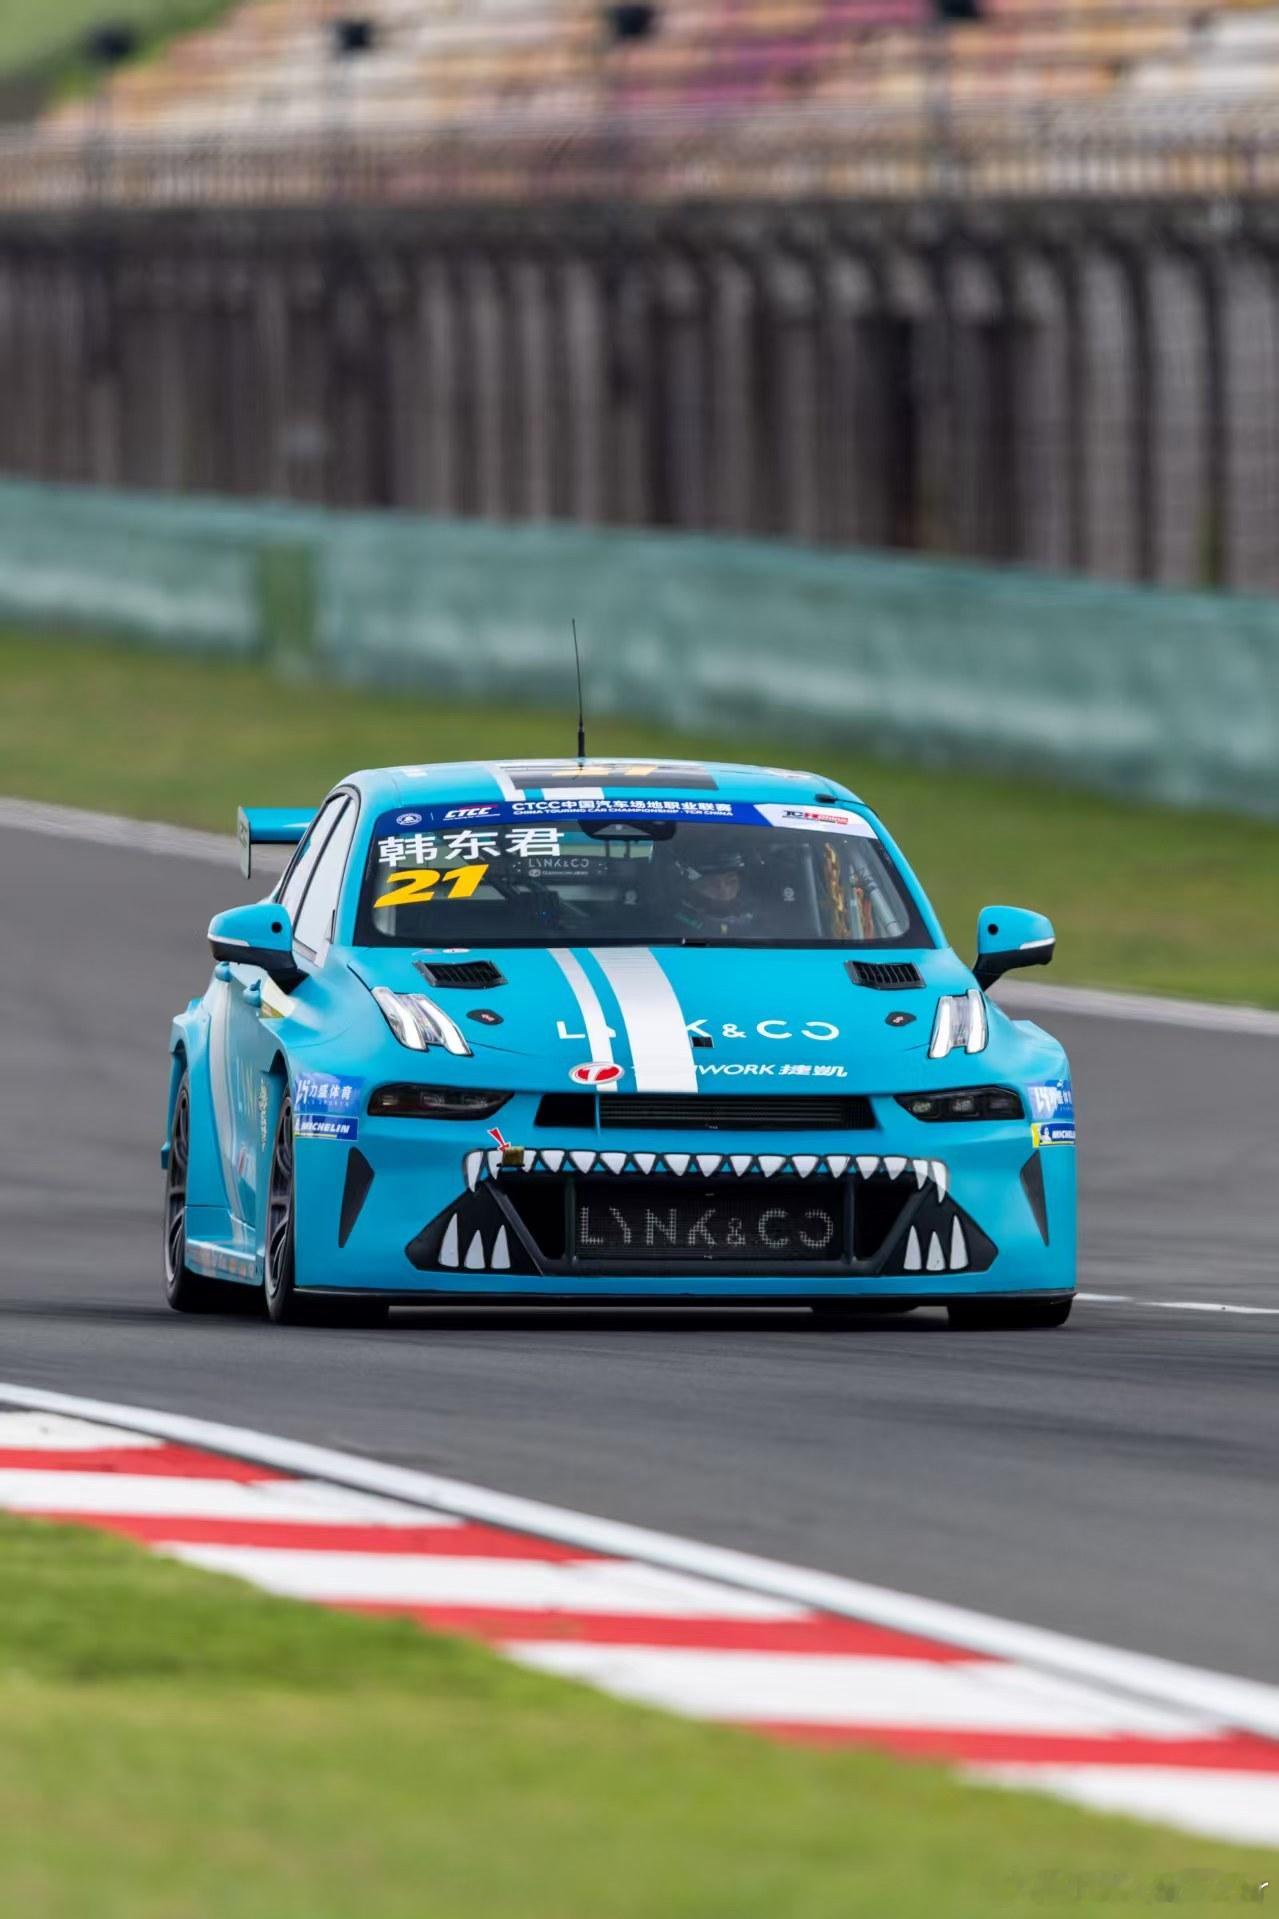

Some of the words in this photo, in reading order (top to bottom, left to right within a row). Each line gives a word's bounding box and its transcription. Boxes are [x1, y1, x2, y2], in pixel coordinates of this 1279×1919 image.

[445, 807, 493, 818] CTCC
[378, 827, 564, 867] 韩东君
[373, 864, 489, 909] 21
[301, 1121, 351, 1134] MICHELIN
